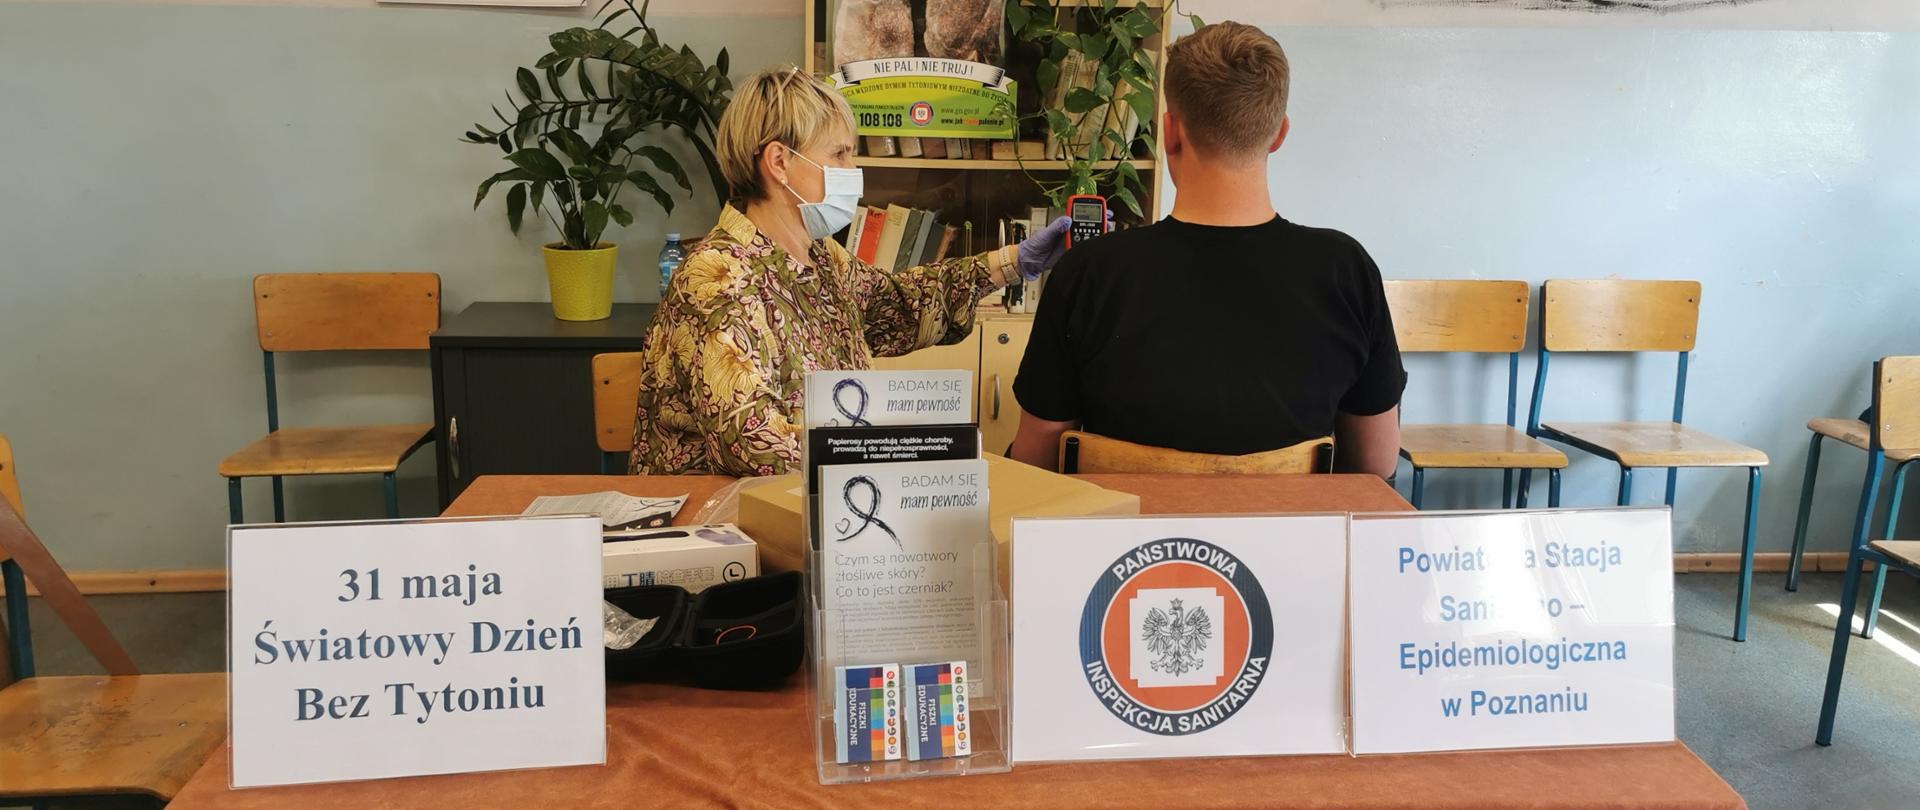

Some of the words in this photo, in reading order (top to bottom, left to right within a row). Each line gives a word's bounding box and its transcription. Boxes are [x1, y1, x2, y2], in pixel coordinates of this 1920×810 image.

[874, 62, 891, 73] NIE
[894, 61, 912, 71] PAL
[921, 61, 938, 71] NIE
[942, 62, 968, 75] TRUJ
[859, 113, 880, 127] 108
[882, 113, 902, 127] 108
[888, 380, 938, 391] BADAM
[943, 380, 962, 394] SIĘ
[887, 401, 914, 412] mam
[916, 396, 961, 413] pewność
[827, 438, 862, 446] Papierosy
[864, 437, 898, 445] powodują
[833, 444, 866, 453] prowadzą
[901, 475, 953, 488] BADAM
[958, 473, 979, 487] SIĘ
[900, 496, 929, 509] mam
[931, 491, 978, 511] pewność
[835, 554, 869, 567] Czym
[873, 555, 886, 566] są
[890, 551, 959, 563] nowotwory
[1112, 541, 1238, 581] PAŃSTWOWA
[1398, 545, 1536, 574] Powiata
[1544, 540, 1622, 573] Stacja
[337, 567, 384, 603] 31
[400, 564, 503, 606] maja
[836, 568, 884, 582] złośliwe
[888, 566, 926, 579] skóry?
[836, 586, 853, 597] Co
[857, 585, 869, 596] to
[872, 583, 894, 597] jest
[898, 580, 954, 594] czerniak?
[253, 620, 456, 666] Światowy
[468, 617, 583, 654] Dzień
[1399, 637, 1627, 675] Epidemiologiczna
[294, 687, 370, 721] Bez
[384, 676, 546, 724] Tytoniu
[1086, 660, 1174, 733] INSPEKCJA
[1178, 655, 1267, 733] SANITARNA
[1441, 697, 1462, 717] w
[1470, 686, 1588, 717] Poznaniu
[849, 687, 858, 746] EDUKACYJNE
[859, 702, 867, 729] FISZKI
[918, 685, 928, 743] EDUKACYJNE
[929, 699, 937, 726] FISZKI
